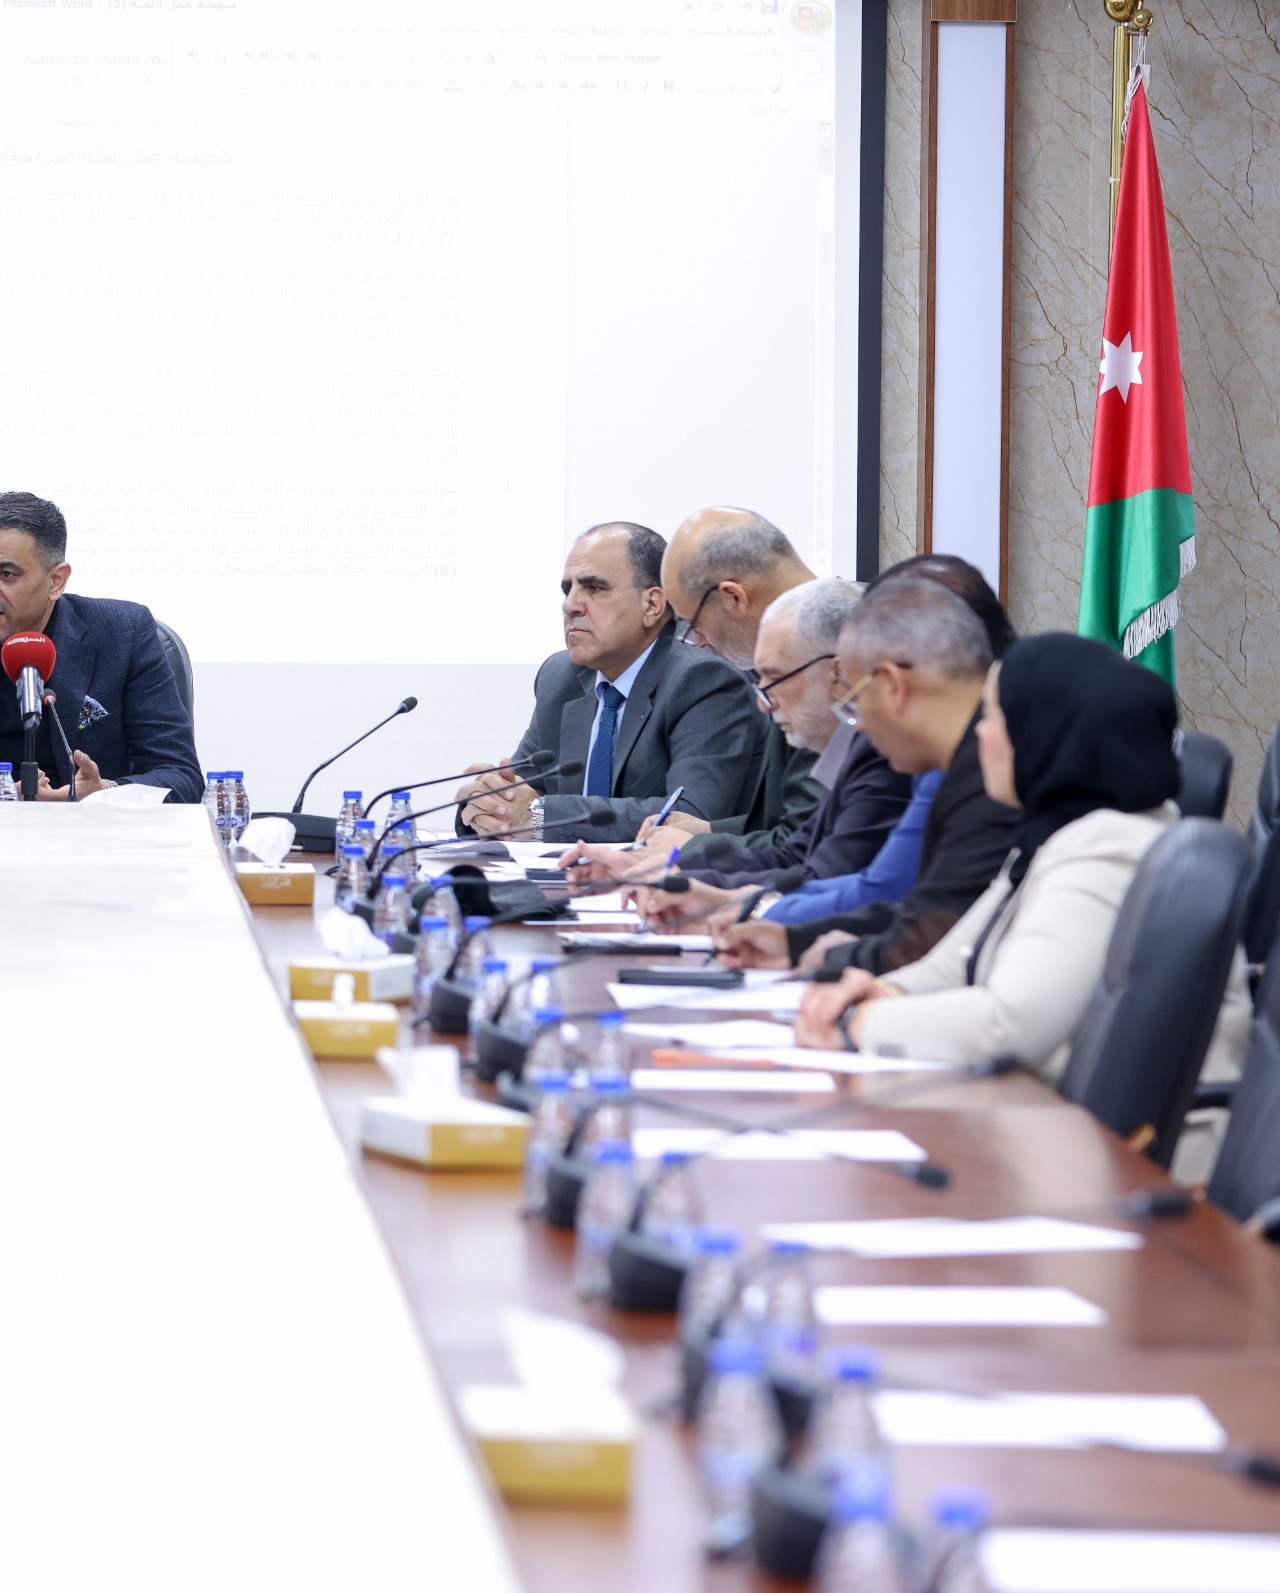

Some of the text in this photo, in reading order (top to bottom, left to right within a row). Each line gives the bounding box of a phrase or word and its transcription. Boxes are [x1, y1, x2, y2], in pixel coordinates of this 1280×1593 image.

[3, 0, 92, 8] Microsoft Word
[624, 52, 662, 63] Roman
[0, 145, 77, 168] المراجعة
[7, 635, 46, 646] المملكة
